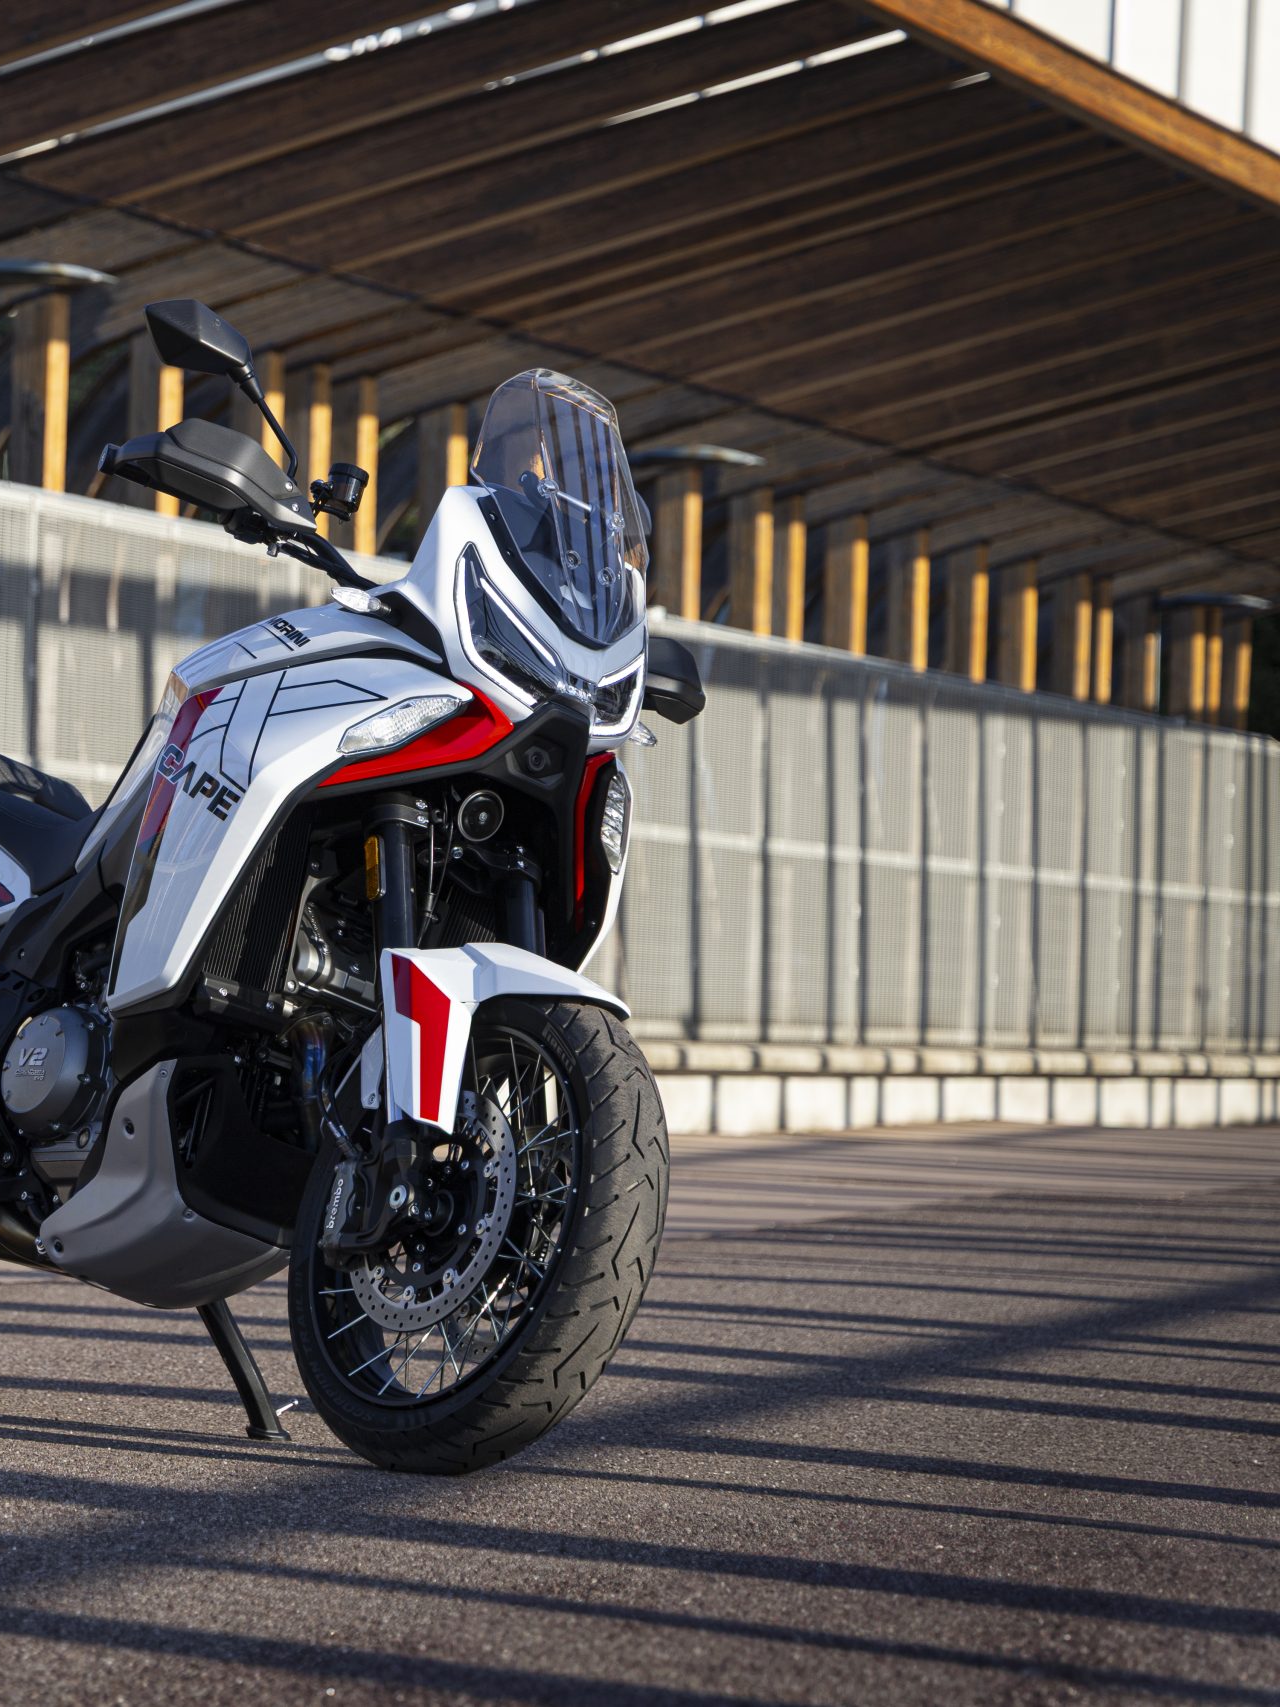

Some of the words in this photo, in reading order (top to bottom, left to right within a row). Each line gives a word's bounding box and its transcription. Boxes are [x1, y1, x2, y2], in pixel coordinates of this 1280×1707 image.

[157, 743, 241, 821] CAPE
[18, 1047, 48, 1067] V2
[326, 1179, 344, 1229] brembo
